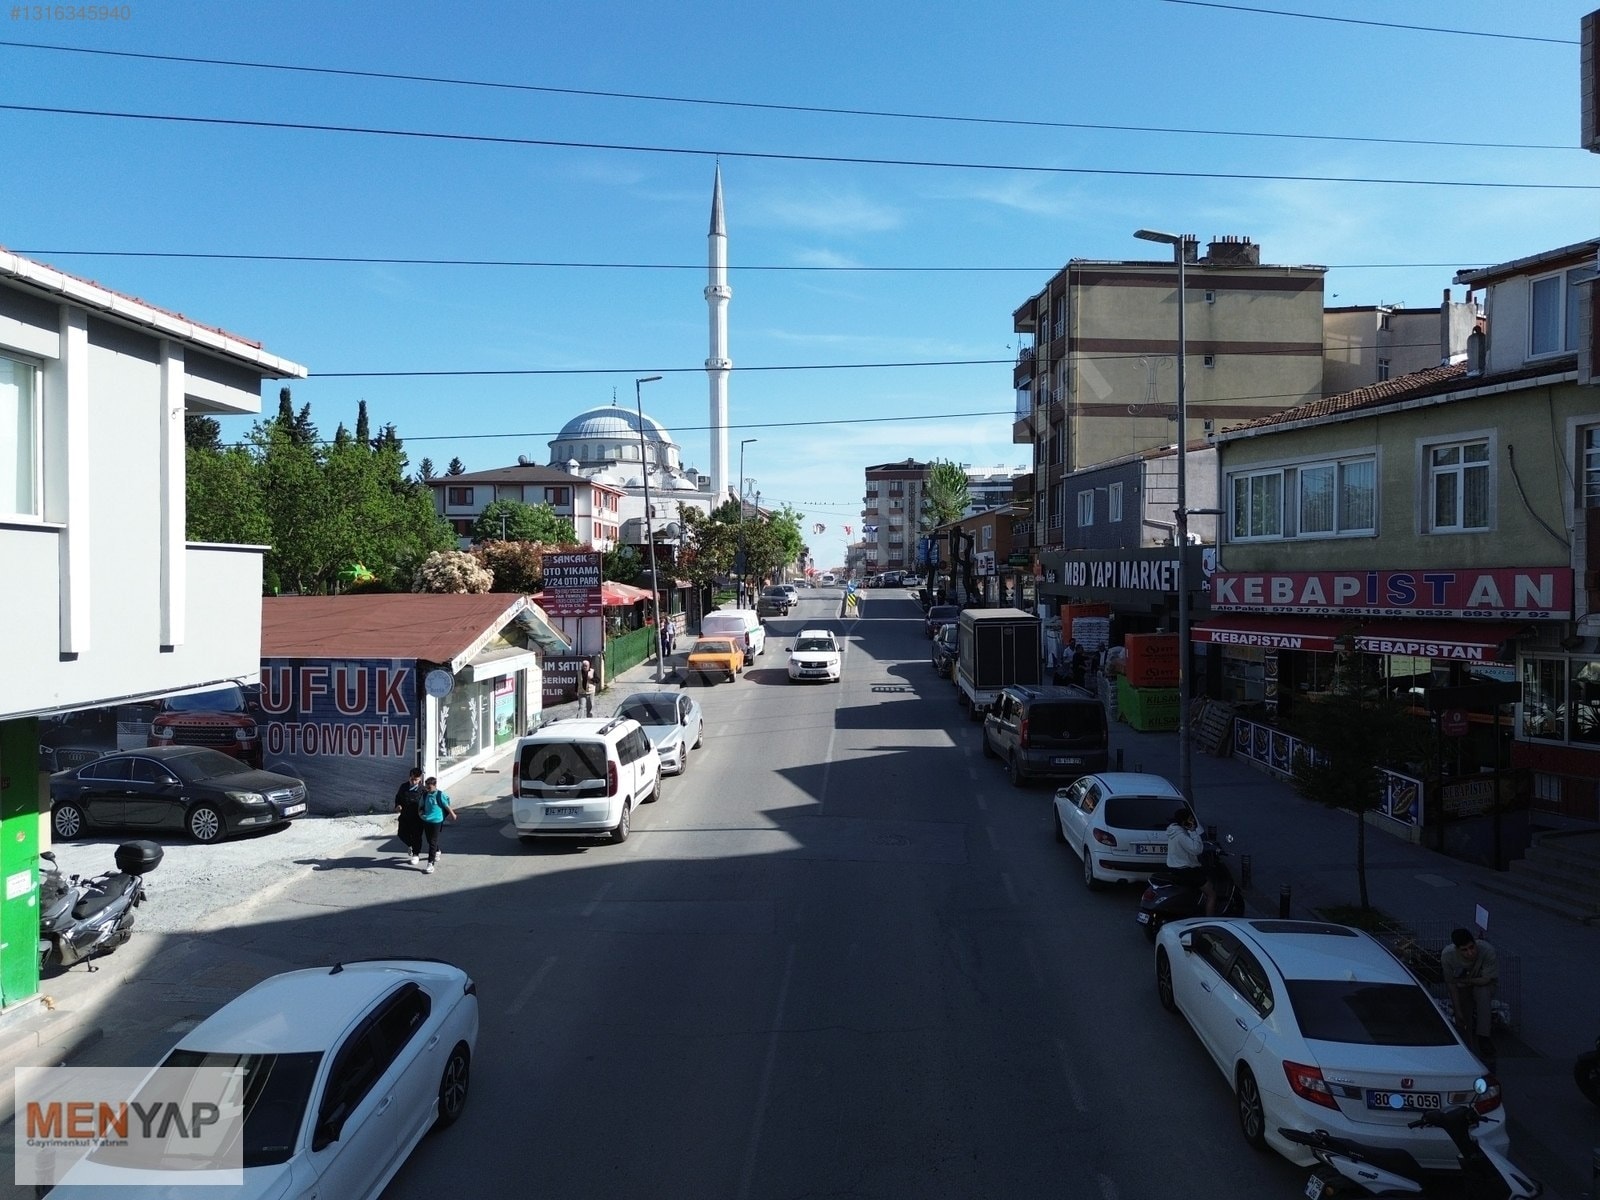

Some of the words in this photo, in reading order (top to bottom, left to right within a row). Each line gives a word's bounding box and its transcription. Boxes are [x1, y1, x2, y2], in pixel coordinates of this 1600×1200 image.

[553, 555, 587, 564] SANCAK
[543, 567, 561, 576] OTO
[563, 566, 599, 575] YIKAMA
[1064, 561, 1087, 586] MBD
[1090, 561, 1116, 588] YAPI
[1119, 560, 1180, 591] MARKET
[544, 578, 563, 587] 7/24
[564, 577, 579, 586] OTO
[579, 576, 599, 585] PARK
[260, 666, 410, 716] UFUK
[267, 716, 410, 758] OTOMOTİV
[1375, 1093, 1388, 1107] 80
[1417, 1095, 1439, 1108] 059
